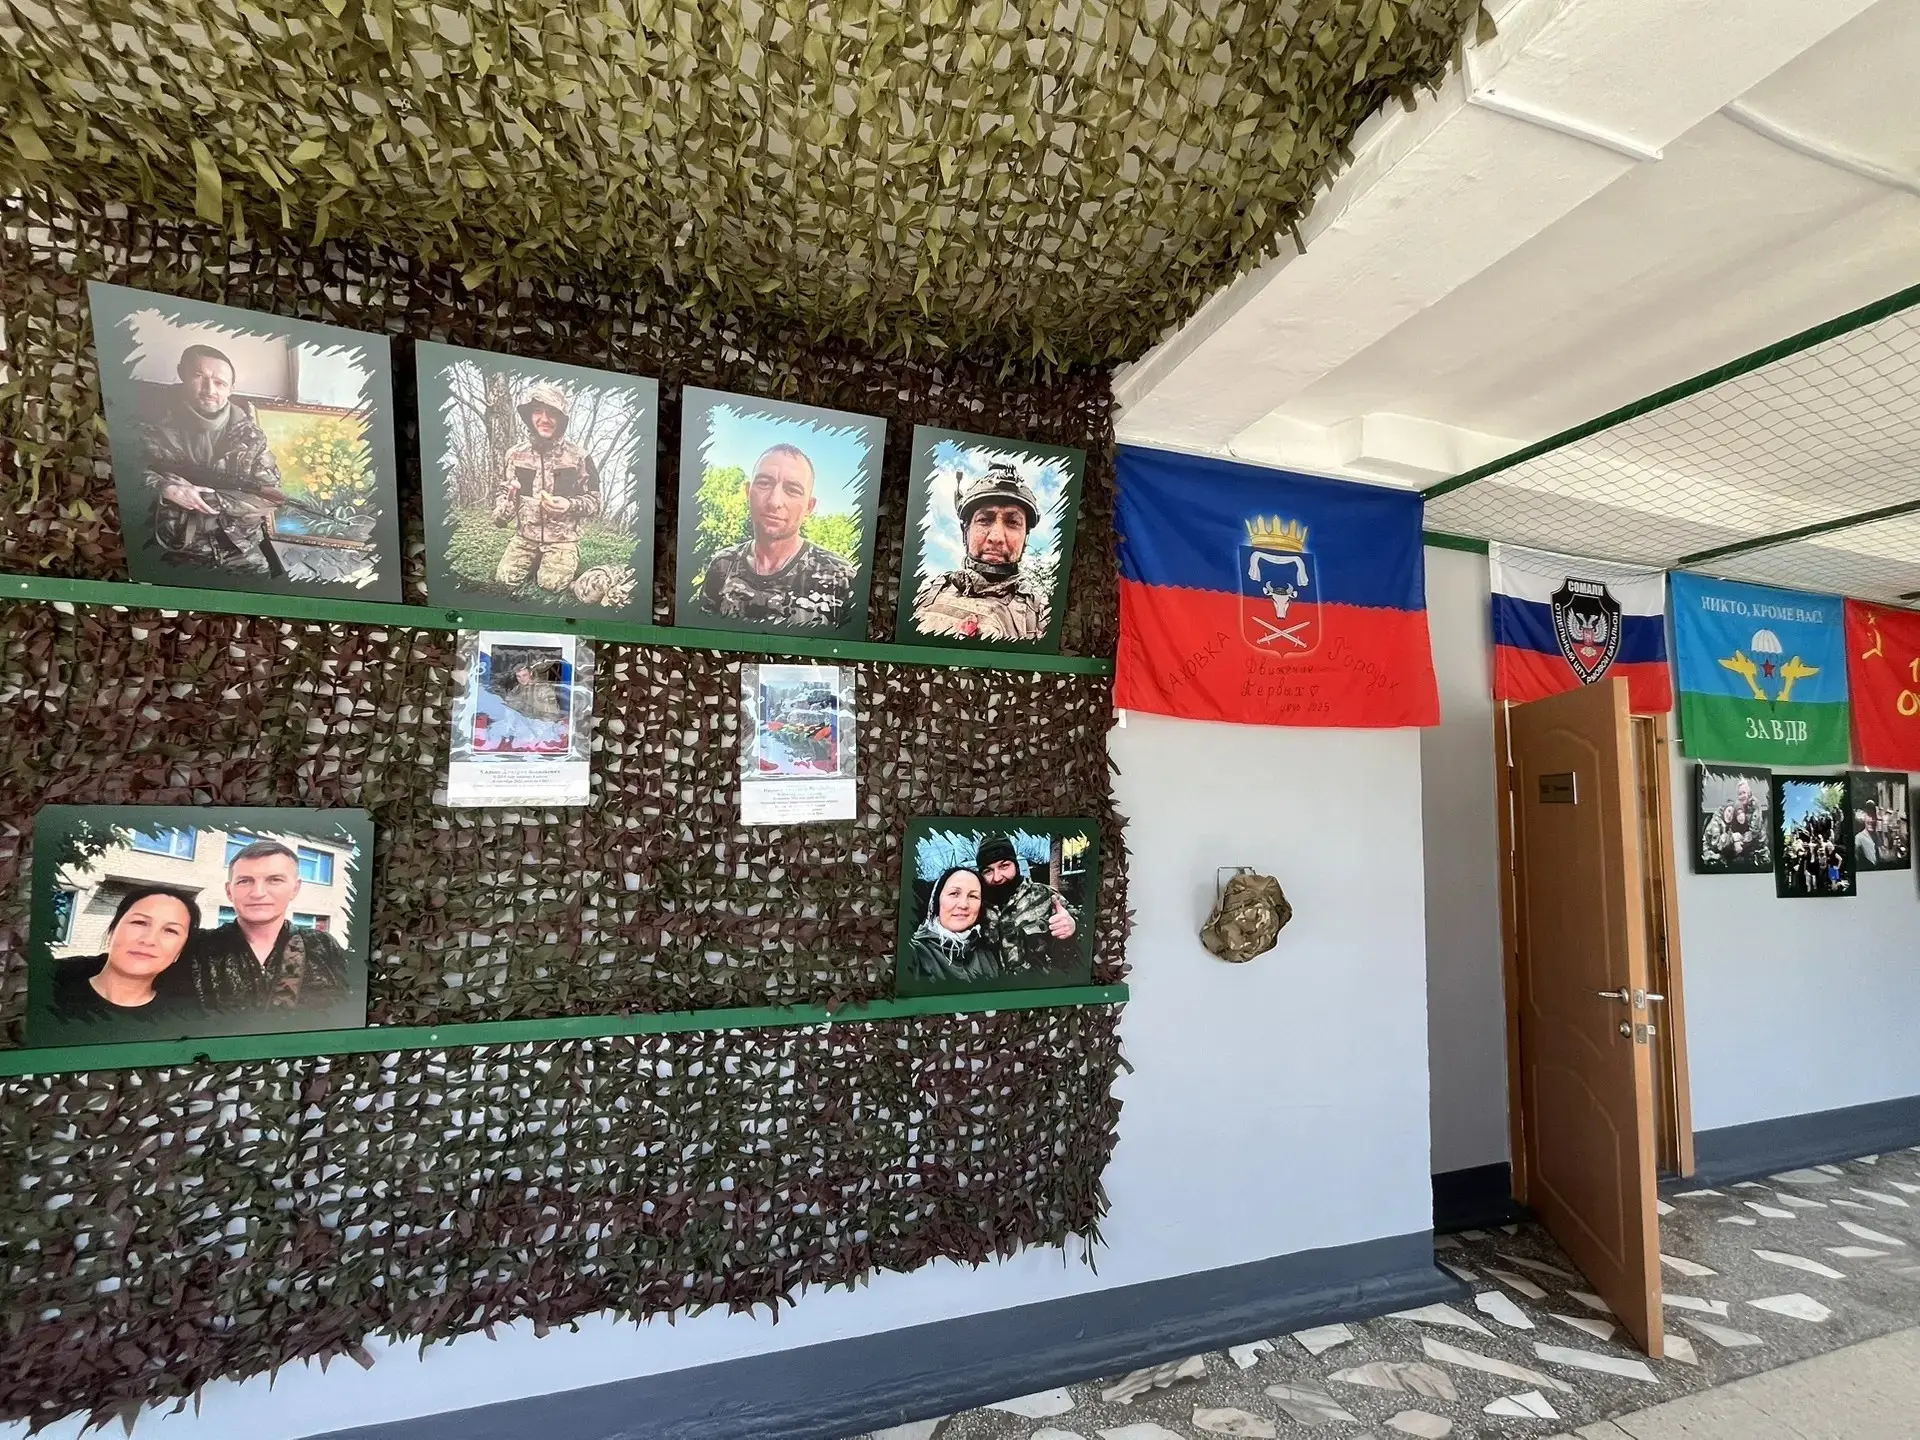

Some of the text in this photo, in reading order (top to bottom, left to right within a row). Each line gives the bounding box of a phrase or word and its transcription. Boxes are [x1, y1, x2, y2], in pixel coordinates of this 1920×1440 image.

[1567, 580, 1604, 597] СОМАЛИ
[1701, 596, 1750, 617] НИКТО,
[1752, 603, 1794, 621] КРОМЕ
[1554, 602, 1576, 662] ОТДЕЛЬНЫЙ
[1606, 611, 1619, 657] БАТАЛЬОН
[1745, 717, 1808, 746] ЗА ВДВ
